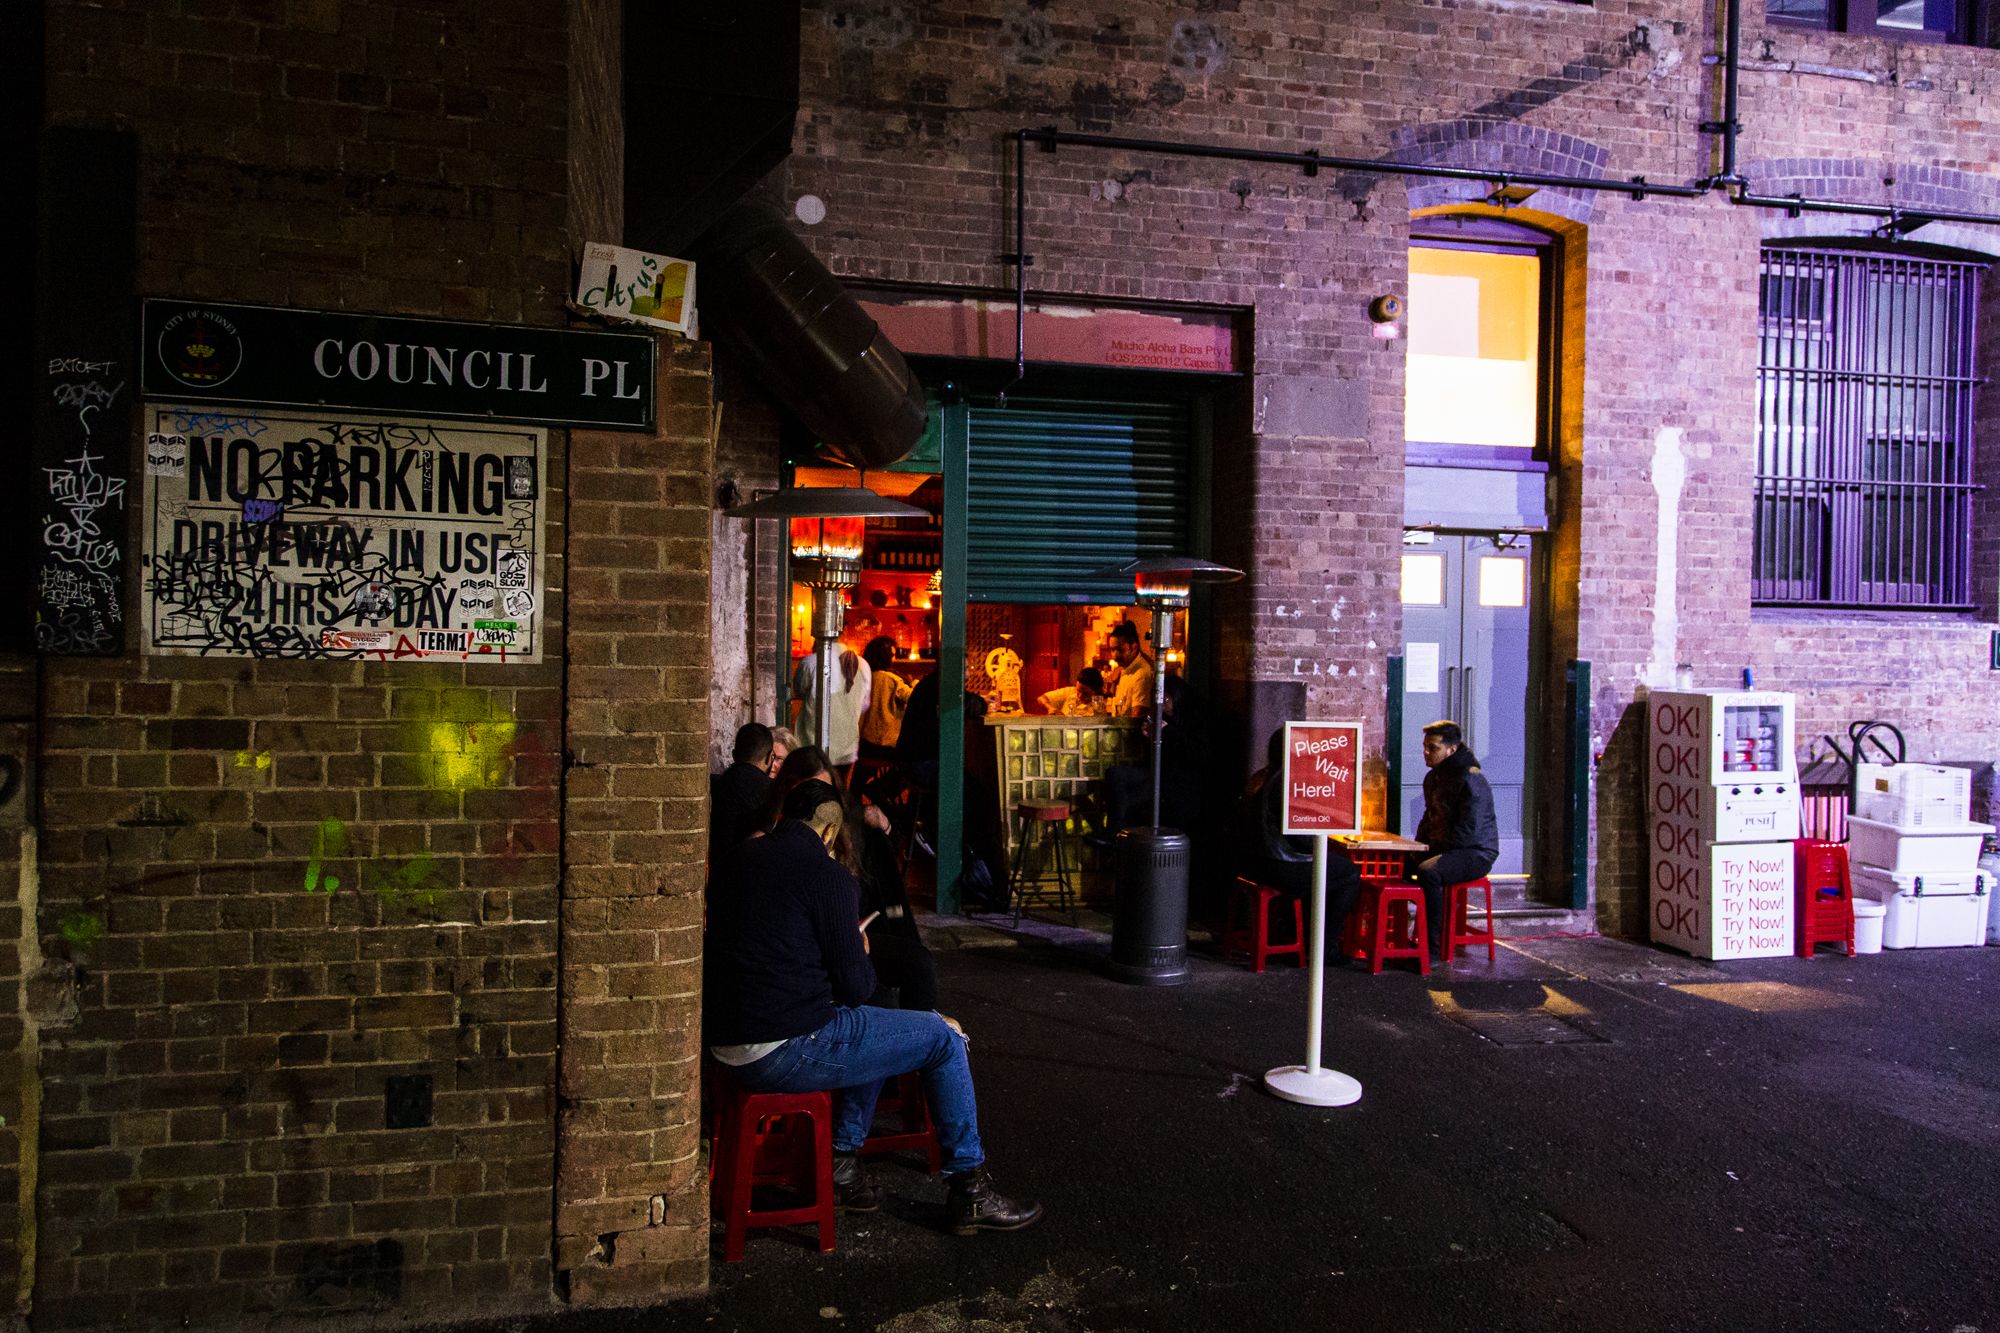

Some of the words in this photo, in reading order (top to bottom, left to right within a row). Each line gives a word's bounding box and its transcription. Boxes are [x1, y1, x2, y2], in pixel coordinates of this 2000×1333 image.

[164, 313, 184, 332] CITY
[186, 309, 200, 320] OF
[202, 311, 239, 336] SYDNEY
[1111, 340, 1145, 351] Mucho
[1147, 342, 1176, 353] Aloha
[1180, 344, 1202, 355] Bars
[313, 338, 548, 393] COUNCIL
[580, 357, 641, 400] PL
[188, 436, 259, 503] NO
[282, 441, 504, 517] PARKING
[173, 518, 376, 571] DRIVEWAY
[388, 528, 425, 572] IN
[499, 578, 526, 588] SLOW
[221, 581, 341, 627] 24HRS
[419, 630, 468, 653] TERM1
[1656, 703, 1700, 739] OK!
[1294, 735, 1348, 758] Please
[1315, 755, 1350, 783] Wait
[1656, 743, 1700, 779] OK!
[1293, 781, 1336, 798] Here!
[1656, 782, 1700, 819] OK!
[1292, 815, 1317, 823] Cantina
[1318, 815, 1331, 823] OK!
[1744, 816, 1770, 826] PUSH
[1656, 821, 1700, 860] OK!
[1656, 860, 1700, 900] OK!
[1722, 860, 1744, 877] Try
[1748, 858, 1784, 873] Now!
[1722, 879, 1744, 896] Try
[1748, 877, 1784, 892] Now!
[1722, 898, 1744, 915] Try
[1748, 896, 1784, 911] Now!
[1656, 898, 1700, 940] OK!
[1722, 917, 1744, 934] Try
[1748, 915, 1784, 930] Now!
[1722, 936, 1744, 953] Try
[1748, 934, 1784, 949] Now!
